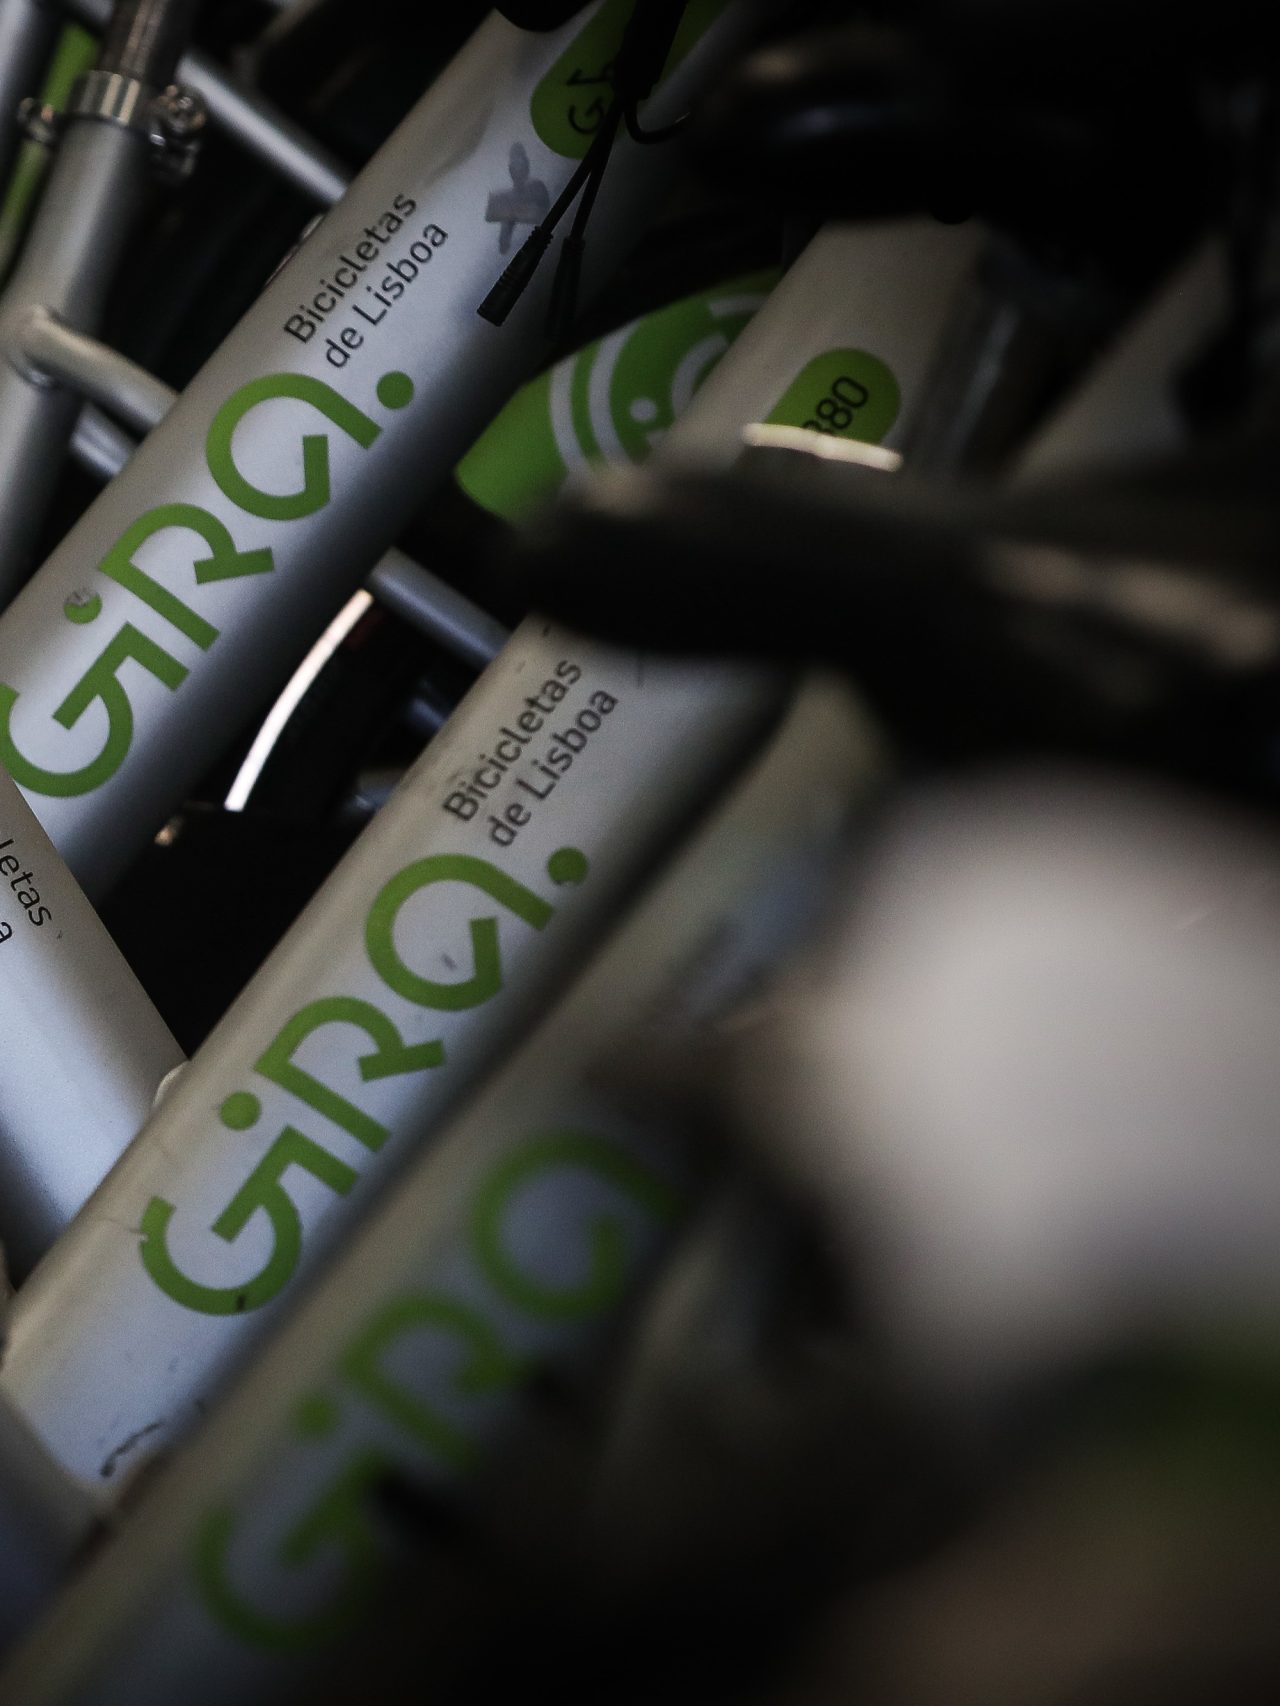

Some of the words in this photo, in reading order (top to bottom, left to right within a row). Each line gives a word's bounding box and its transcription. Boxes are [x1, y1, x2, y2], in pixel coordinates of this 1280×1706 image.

[283, 193, 417, 344] Bicicletas
[325, 326, 365, 369] de
[352, 223, 449, 326] Lisboa
[442, 659, 582, 822] Bicicletas
[488, 803, 532, 848] de
[516, 689, 619, 800] Lisboa
